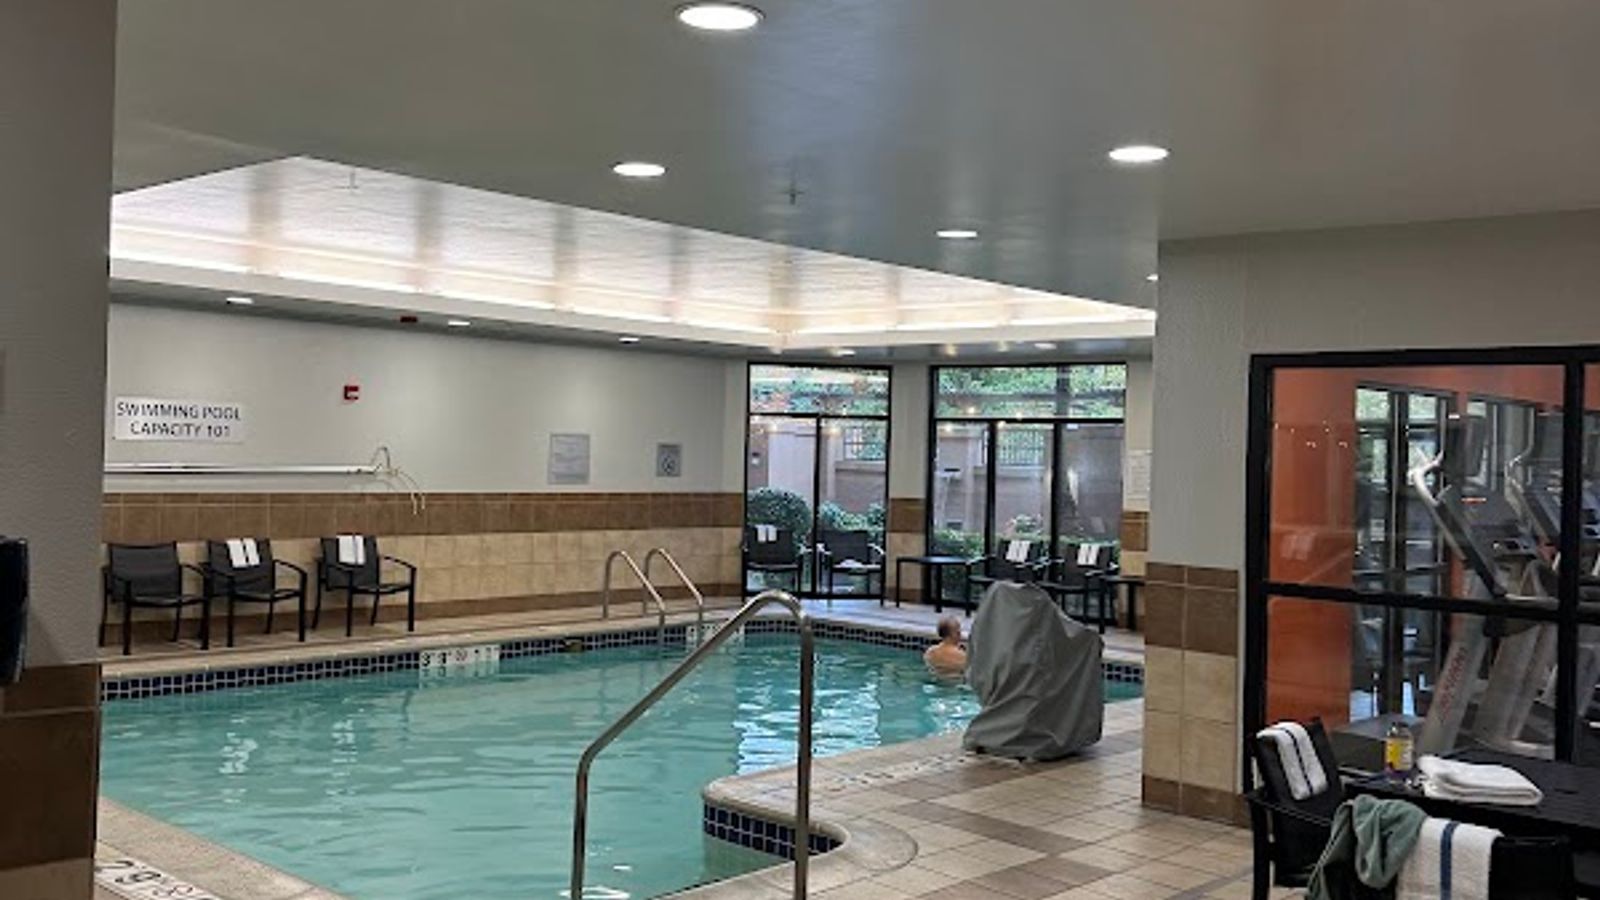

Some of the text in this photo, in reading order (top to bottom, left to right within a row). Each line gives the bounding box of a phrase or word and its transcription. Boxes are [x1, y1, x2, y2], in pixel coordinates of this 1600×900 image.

[117, 401, 241, 421] SWIMMING POOL
[130, 420, 231, 438] CAPACITY 101
